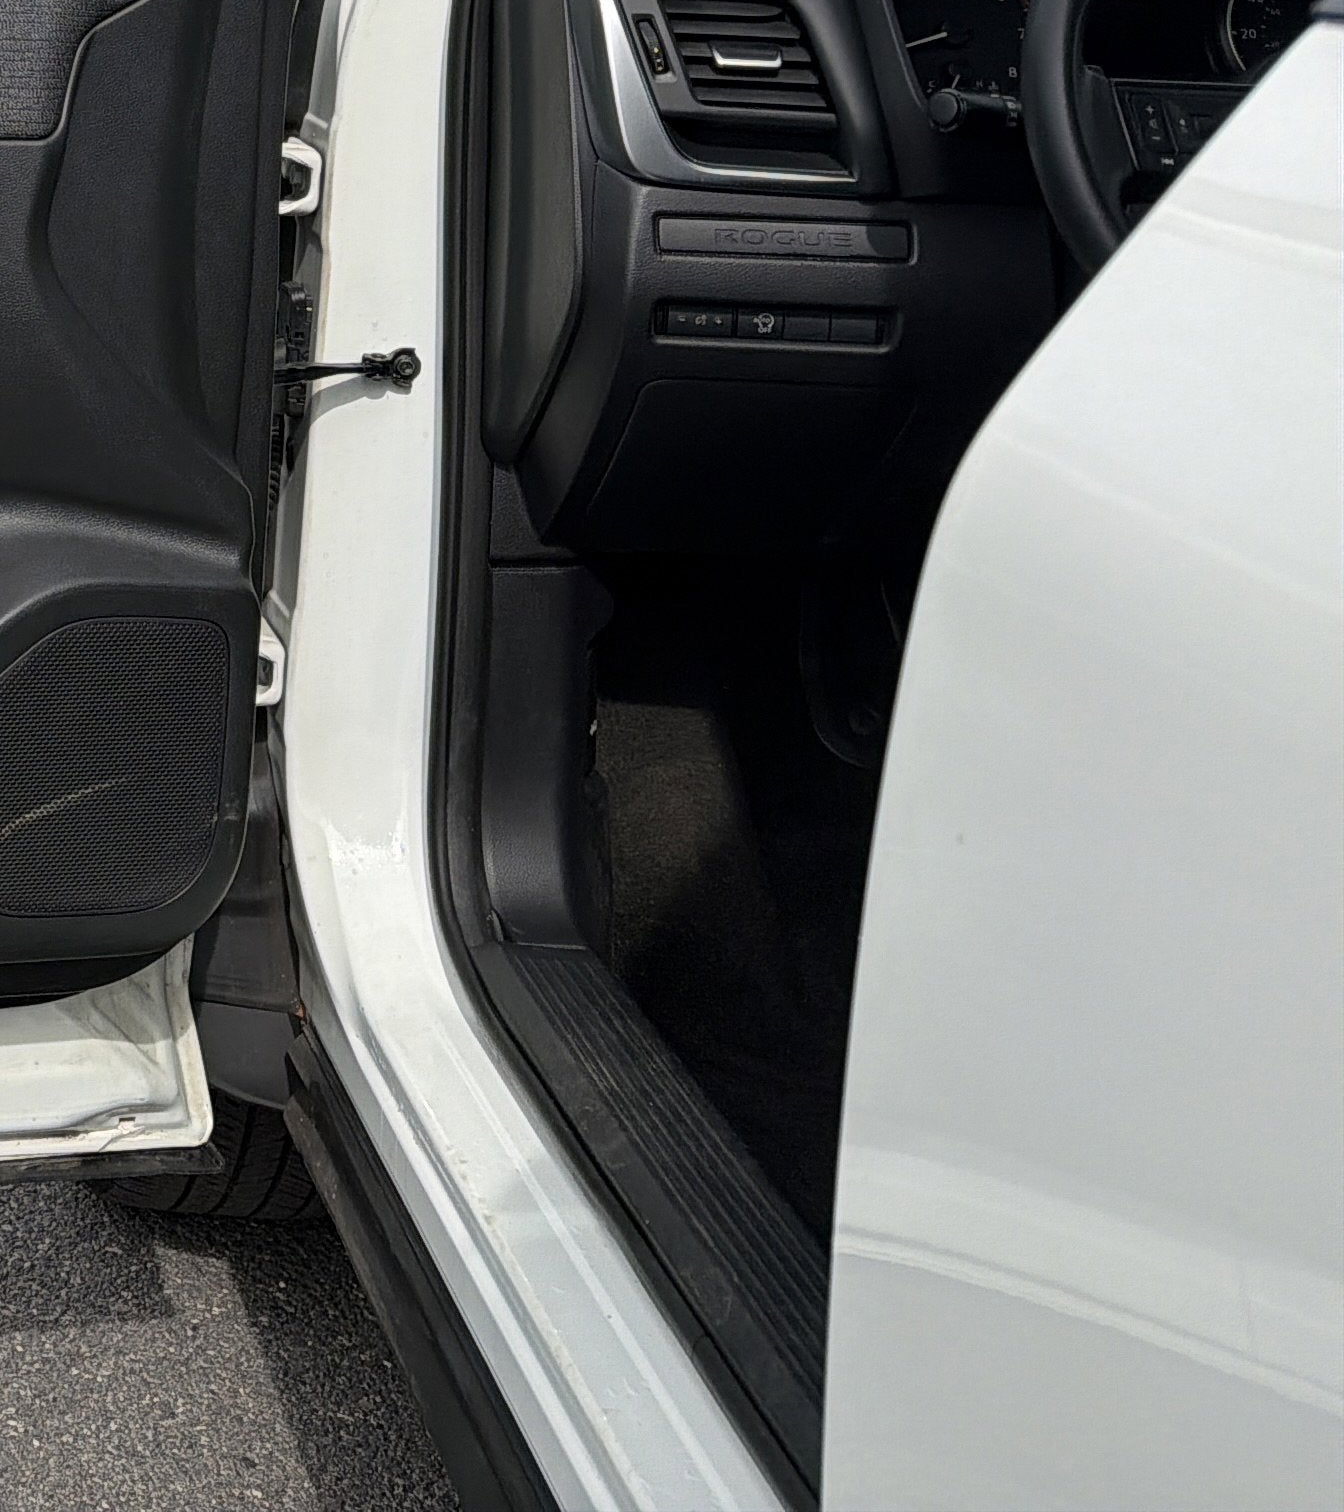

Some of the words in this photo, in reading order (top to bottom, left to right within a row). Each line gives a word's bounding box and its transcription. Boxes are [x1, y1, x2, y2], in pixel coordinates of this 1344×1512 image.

[1017, 27, 1025, 40] 7
[1240, 28, 1257, 39] 20
[1008, 67, 1018, 78] 8
[714, 228, 853, 248] ROGUE
